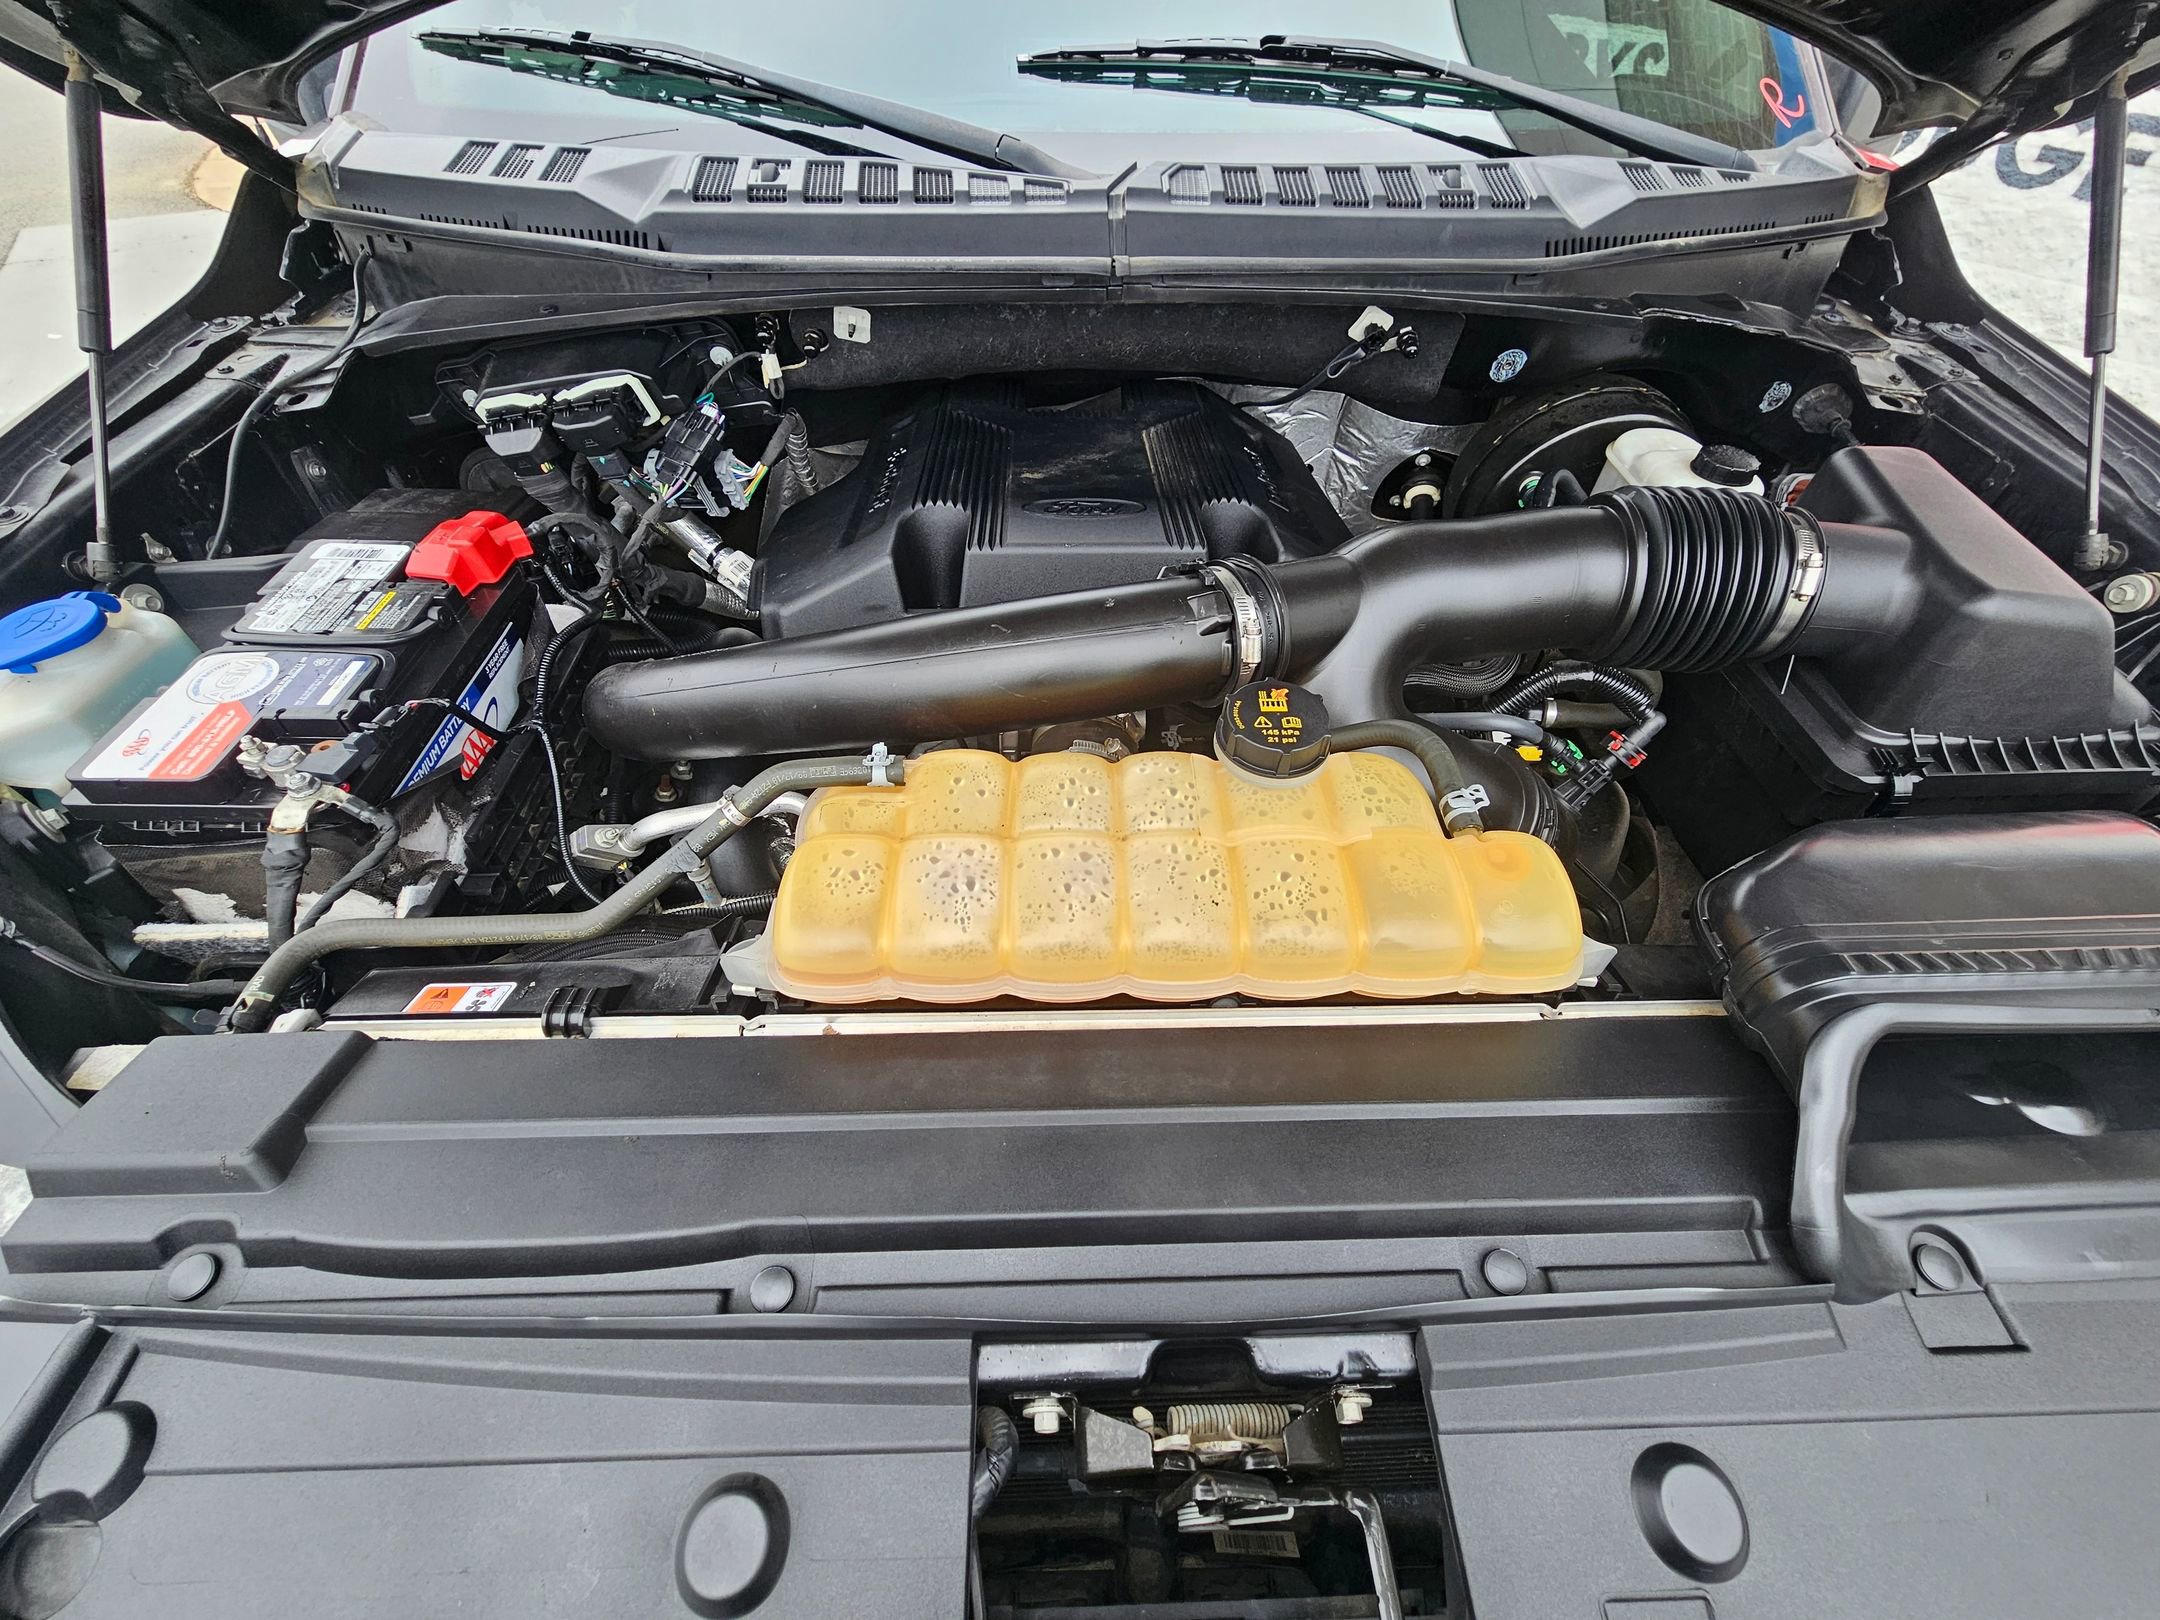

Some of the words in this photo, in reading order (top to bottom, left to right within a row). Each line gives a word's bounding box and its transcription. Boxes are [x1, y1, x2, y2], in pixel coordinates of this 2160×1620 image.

[1759, 77, 1806, 128] R
[487, 652, 500, 669] YEAR
[497, 638, 508, 656] FREE
[461, 729, 498, 780] AAA
[1282, 736, 1297, 744] psi
[249, 975, 265, 991] RAD
